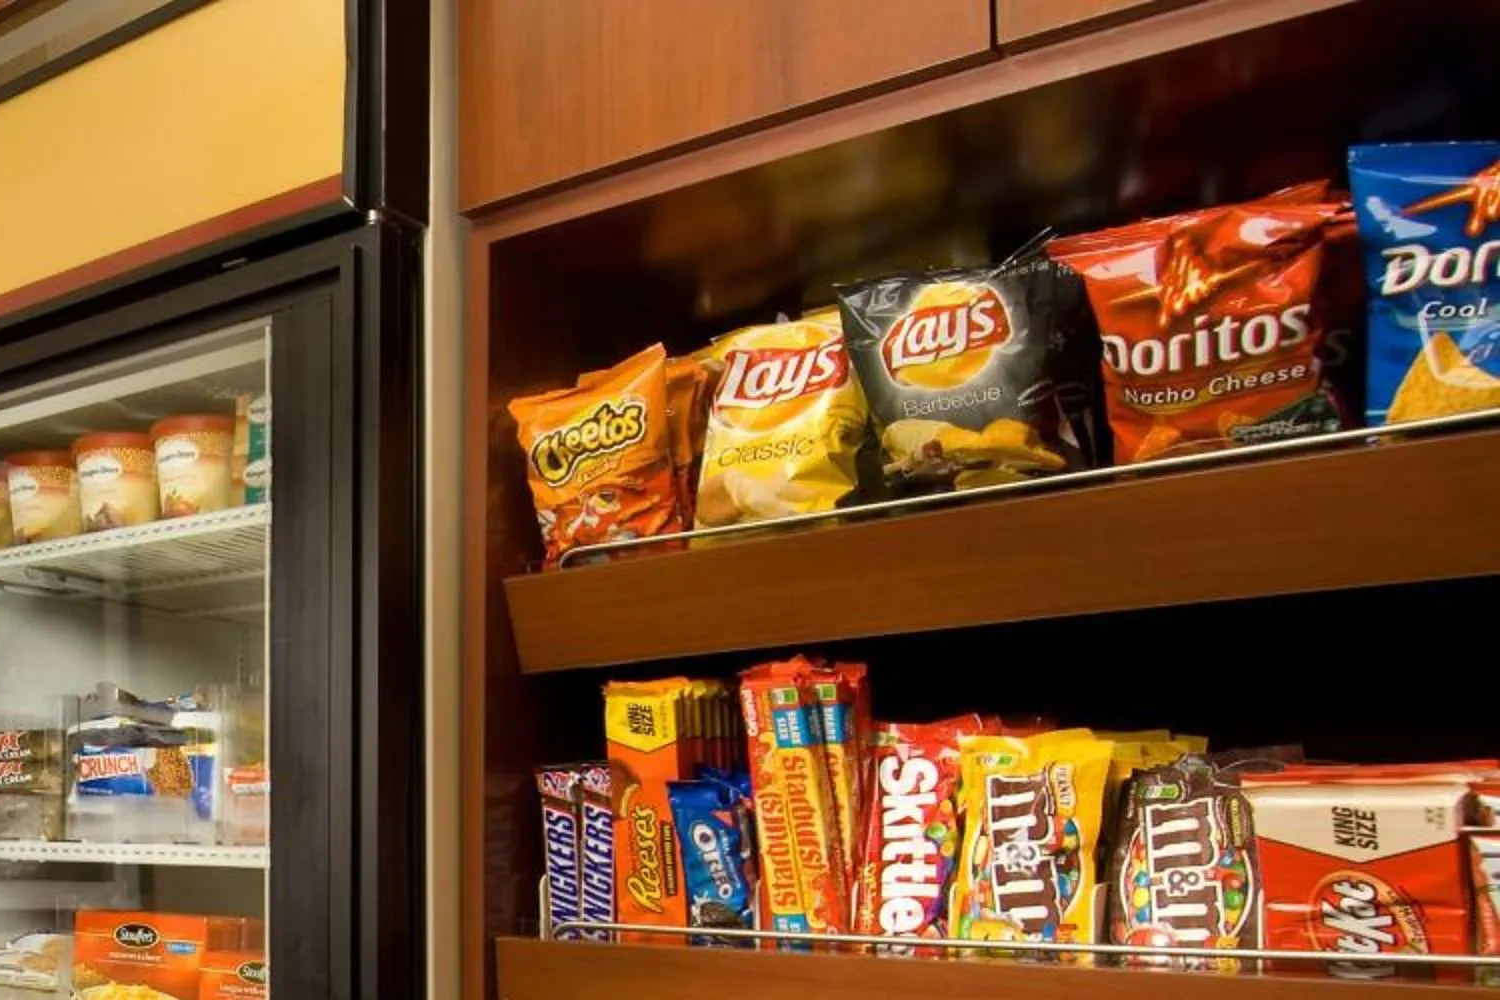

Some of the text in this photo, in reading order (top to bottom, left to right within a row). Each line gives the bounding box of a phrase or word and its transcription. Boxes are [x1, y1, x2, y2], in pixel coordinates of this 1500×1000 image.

[1124, 362, 1306, 407] Nacho Cheese
[902, 385, 1004, 418] Barbecue
[531, 402, 646, 484] Cheetos
[717, 435, 815, 468] Classic
[627, 703, 642, 735] KING
[640, 704, 656, 737] SIZE
[79, 752, 139, 779] CRUNCH
[1331, 805, 1356, 847] KING
[1355, 809, 1379, 851] SIZE
